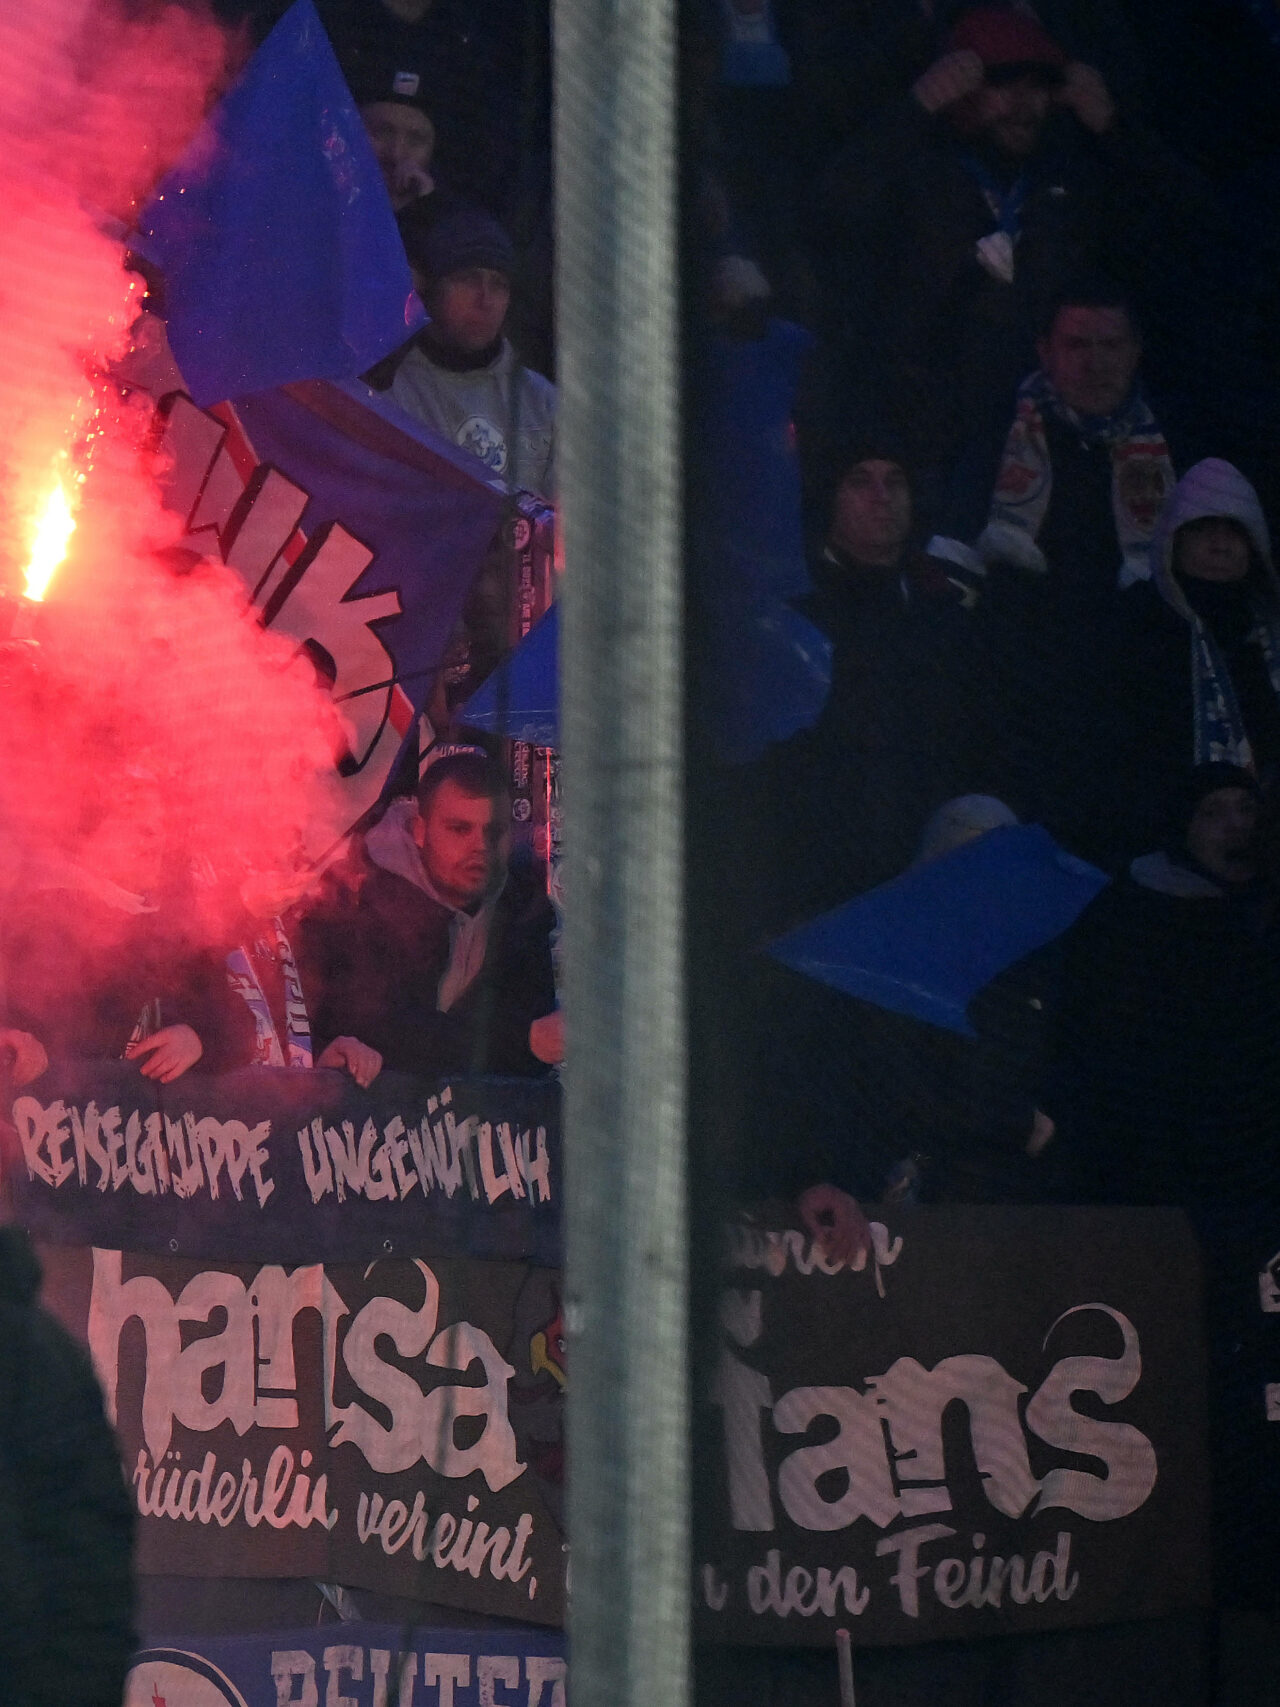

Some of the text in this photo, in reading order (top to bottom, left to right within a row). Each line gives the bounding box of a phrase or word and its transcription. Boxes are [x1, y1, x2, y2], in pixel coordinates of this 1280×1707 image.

[357, 1490, 537, 1600] vereint,
[748, 1549, 870, 1617] den
[875, 1523, 1080, 1618] Feind
